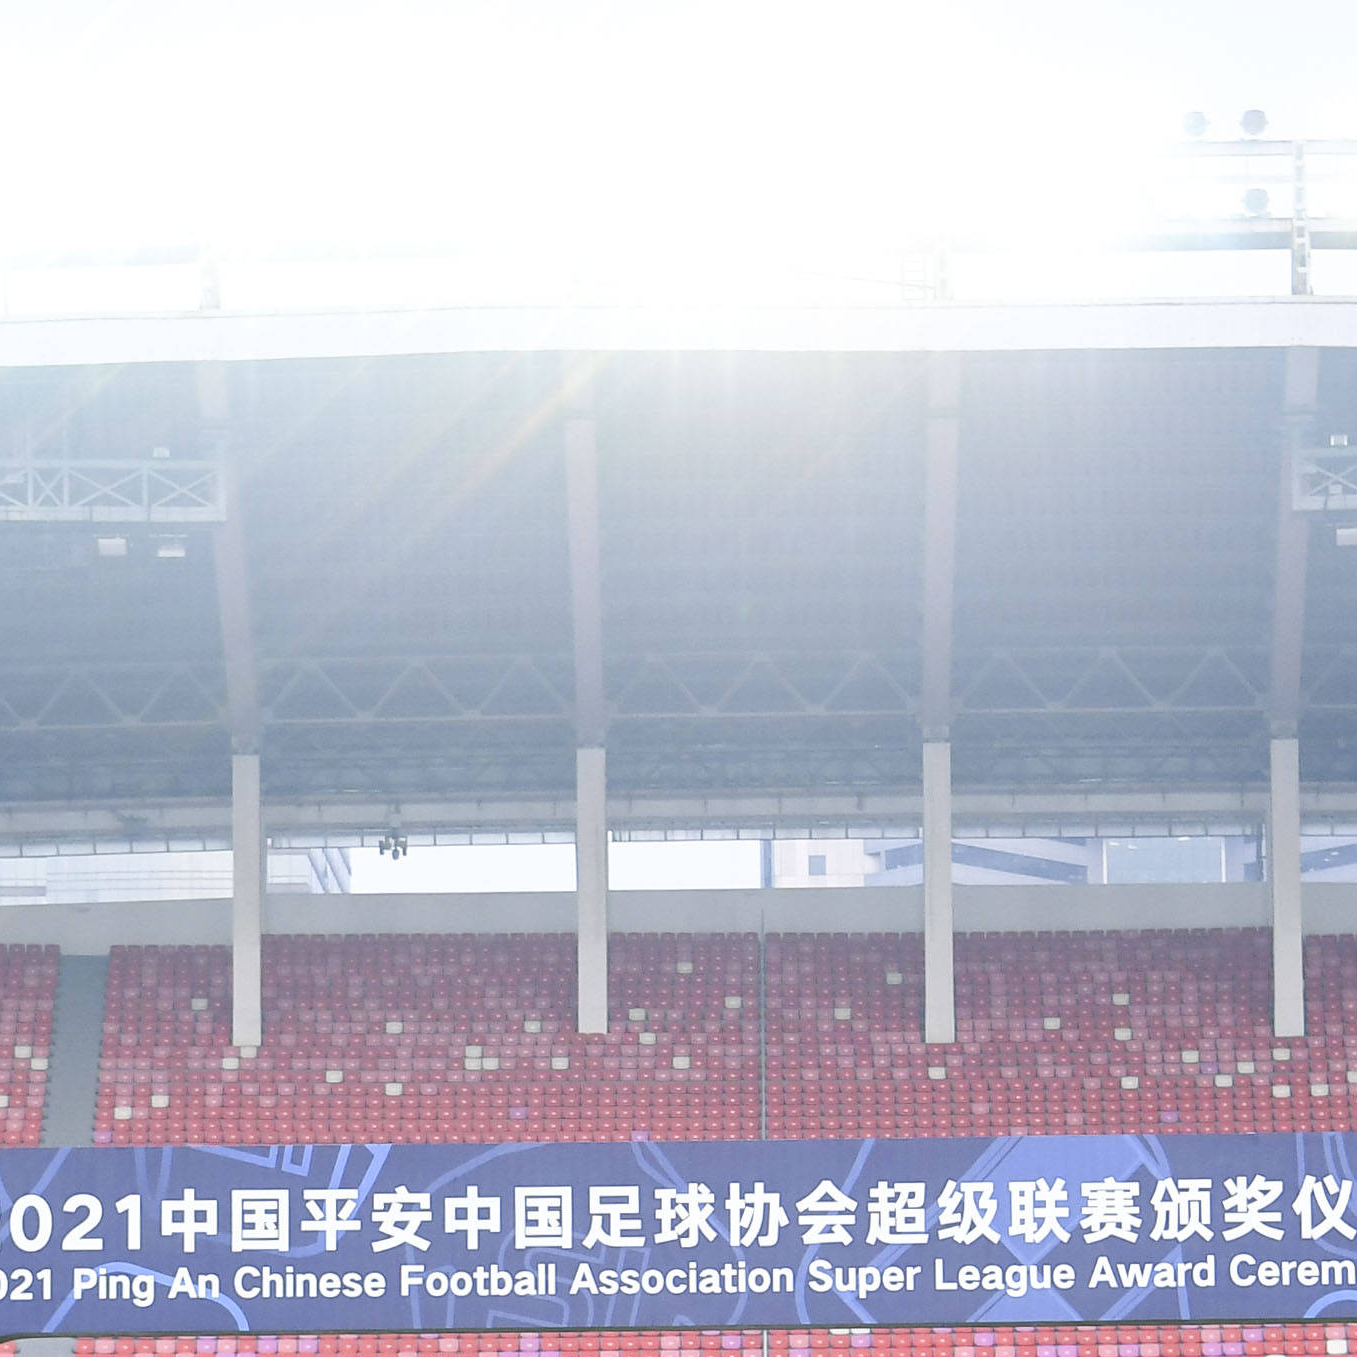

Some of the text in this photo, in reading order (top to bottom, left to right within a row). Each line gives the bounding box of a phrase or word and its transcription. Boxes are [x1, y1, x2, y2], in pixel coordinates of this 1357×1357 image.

[73, 1267, 155, 1308] Ping
[170, 1267, 220, 1299] An
[234, 1265, 386, 1299] Chinese
[400, 1263, 556, 1297] Football
[569, 1260, 794, 1295] Association
[808, 1259, 922, 1299] Super
[935, 1258, 1076, 1298] League
[1088, 1255, 1216, 1289] Award
